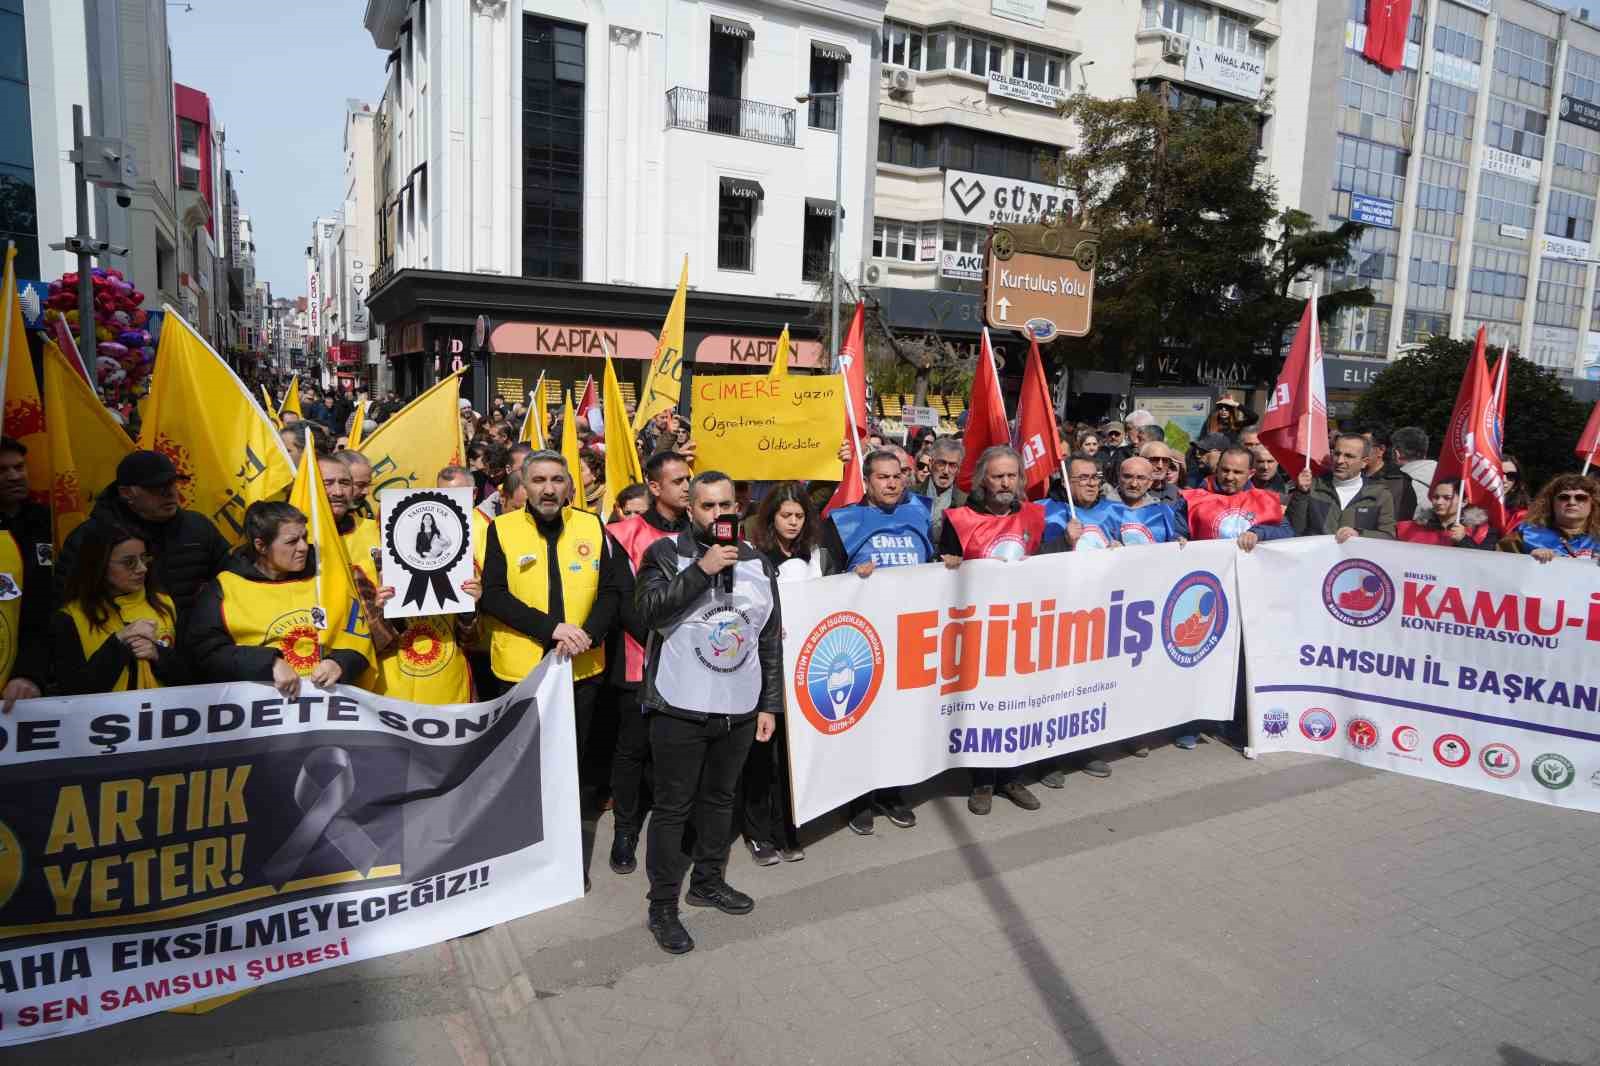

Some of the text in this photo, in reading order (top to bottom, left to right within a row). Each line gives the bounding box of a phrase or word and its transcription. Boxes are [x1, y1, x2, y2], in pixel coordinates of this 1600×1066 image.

[1000, 268, 1057, 295] Kurtuluş
[1060, 276, 1086, 296] Yolu
[537, 327, 618, 354] KAPTAN
[872, 536, 914, 549] EMEK
[1400, 616, 1559, 649] KONFEDERASYONU
[940, 701, 976, 716] Eğitim
[979, 702, 994, 712] Ve
[997, 700, 1026, 712] Bilim
[1076, 680, 1118, 697] Sendikası
[1300, 644, 1600, 713] SAMSUN İL BAŞKAN
[89, 696, 359, 754] ŞİDDETE
[949, 702, 1107, 754] SAMSUN ŞUBESİ
[45, 764, 252, 855] ARTIK
[43, 833, 247, 915] YETER!
[112, 865, 490, 973] EKSİLMEYECEĞİZ!!
[18, 995, 88, 1027] SEN
[100, 965, 237, 1012] SAMSUN
[246, 937, 350, 980] ŞUBESİ
